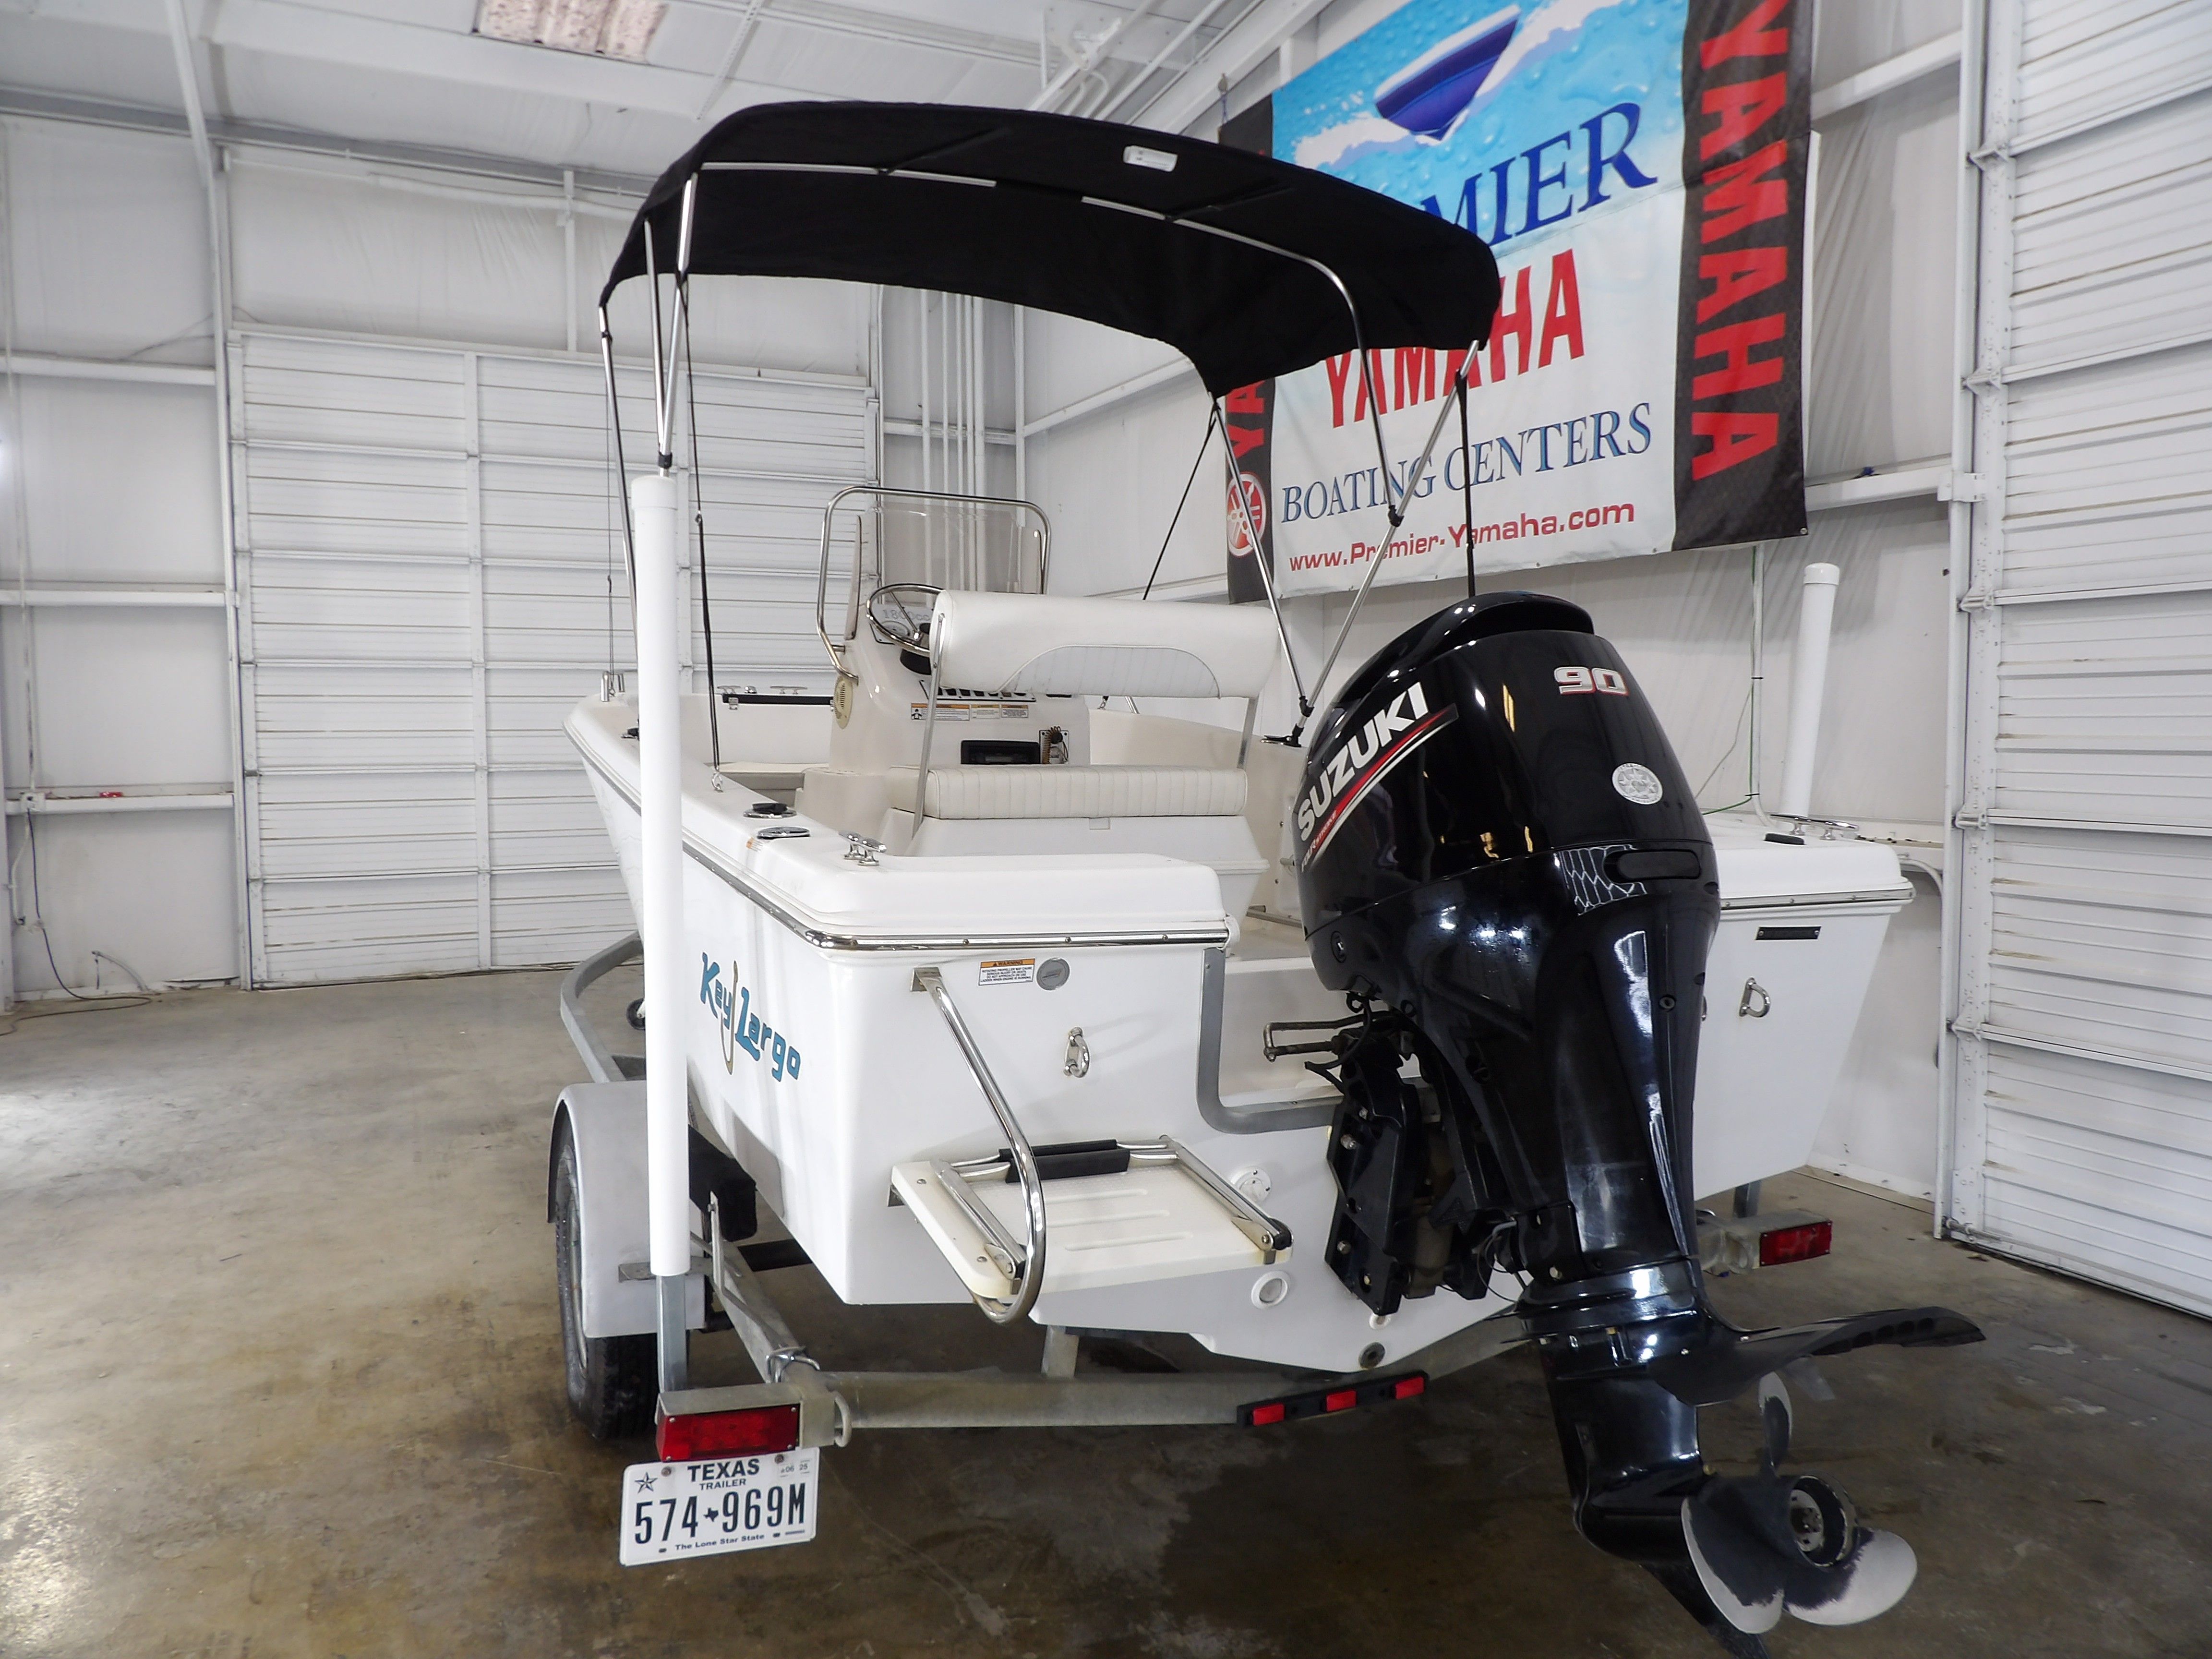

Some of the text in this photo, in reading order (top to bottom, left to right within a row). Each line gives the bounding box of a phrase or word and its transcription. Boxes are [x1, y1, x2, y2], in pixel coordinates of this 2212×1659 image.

[1420, 102, 1658, 246] MIER
[1692, 0, 1789, 481] YAMAHA
[1281, 402, 1652, 523] BOATING CENTERS
[1553, 666, 1629, 697] 90
[1298, 682, 1429, 842] SUZUKI
[700, 951, 801, 1082] Key Largo
[687, 1458, 760, 1482] TEXAS
[699, 1479, 746, 1491] TRAILER
[675, 1533, 765, 1551] The Lone Star State
